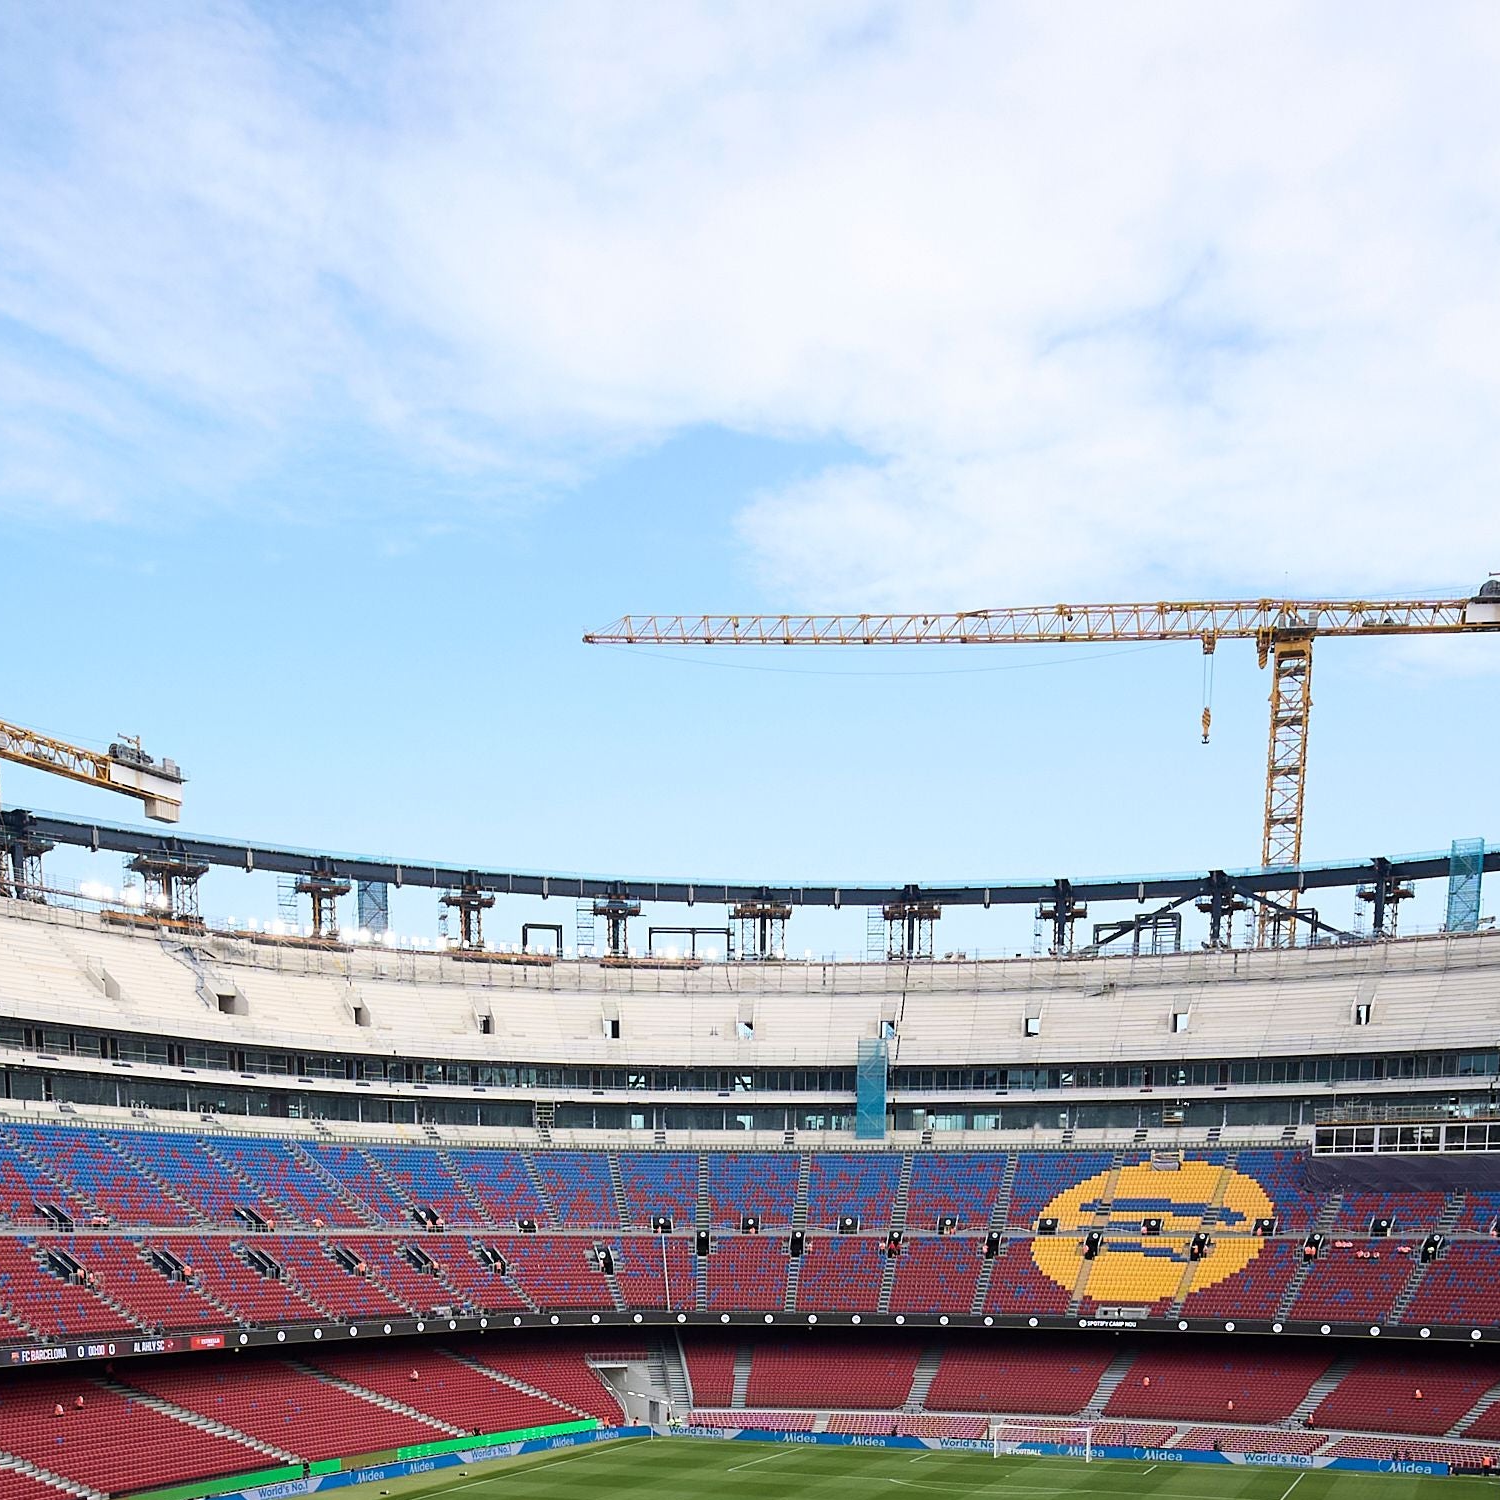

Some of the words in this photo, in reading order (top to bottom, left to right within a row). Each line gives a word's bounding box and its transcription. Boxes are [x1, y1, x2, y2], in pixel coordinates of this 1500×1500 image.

[21, 1351, 31, 1362] FC
[31, 1347, 68, 1361] BARCELONA
[77, 1346, 84, 1358] 0
[108, 1343, 115, 1354] 0
[133, 1341, 142, 1353] AL
[142, 1340, 157, 1352] AHLY
[156, 1340, 165, 1351] SC
[593, 1428, 619, 1441] Midea
[782, 1430, 817, 1444] Midea
[850, 1433, 885, 1447] Midea
[551, 1436, 575, 1449] Midea
[939, 1438, 979, 1449] World's
[1143, 1447, 1183, 1461] Midea
[1244, 1453, 1286, 1462] World's
[409, 1460, 434, 1474] Midea
[1388, 1460, 1432, 1475] Midea
[356, 1469, 384, 1484] Midea
[259, 1484, 290, 1498] World's
[291, 1480, 308, 1492] No.1
